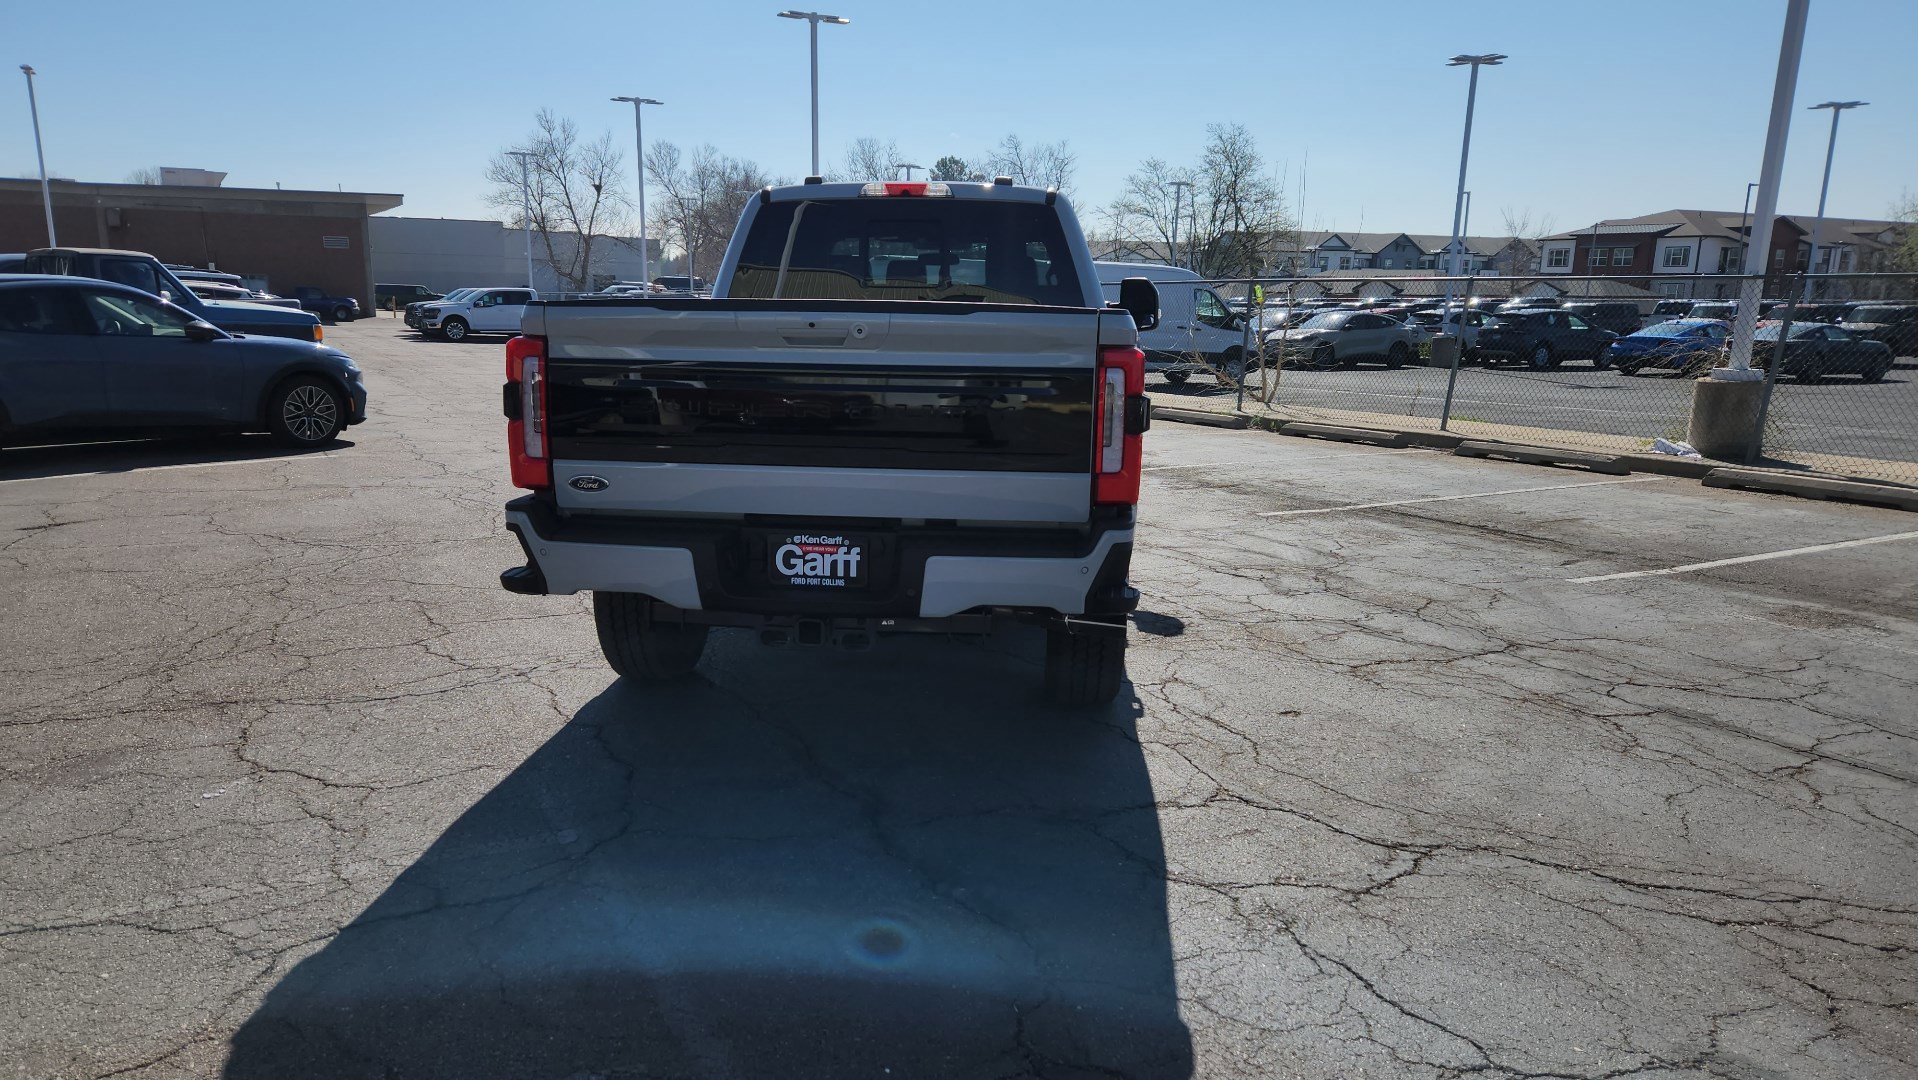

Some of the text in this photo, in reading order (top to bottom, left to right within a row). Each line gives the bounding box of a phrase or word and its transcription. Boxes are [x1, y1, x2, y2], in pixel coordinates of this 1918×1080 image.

[577, 478, 599, 489] Ford
[801, 535, 843, 545] Ken Garff
[775, 544, 861, 577] Garff
[791, 577, 806, 585] FORD
[822, 579, 845, 587] COLLINS
